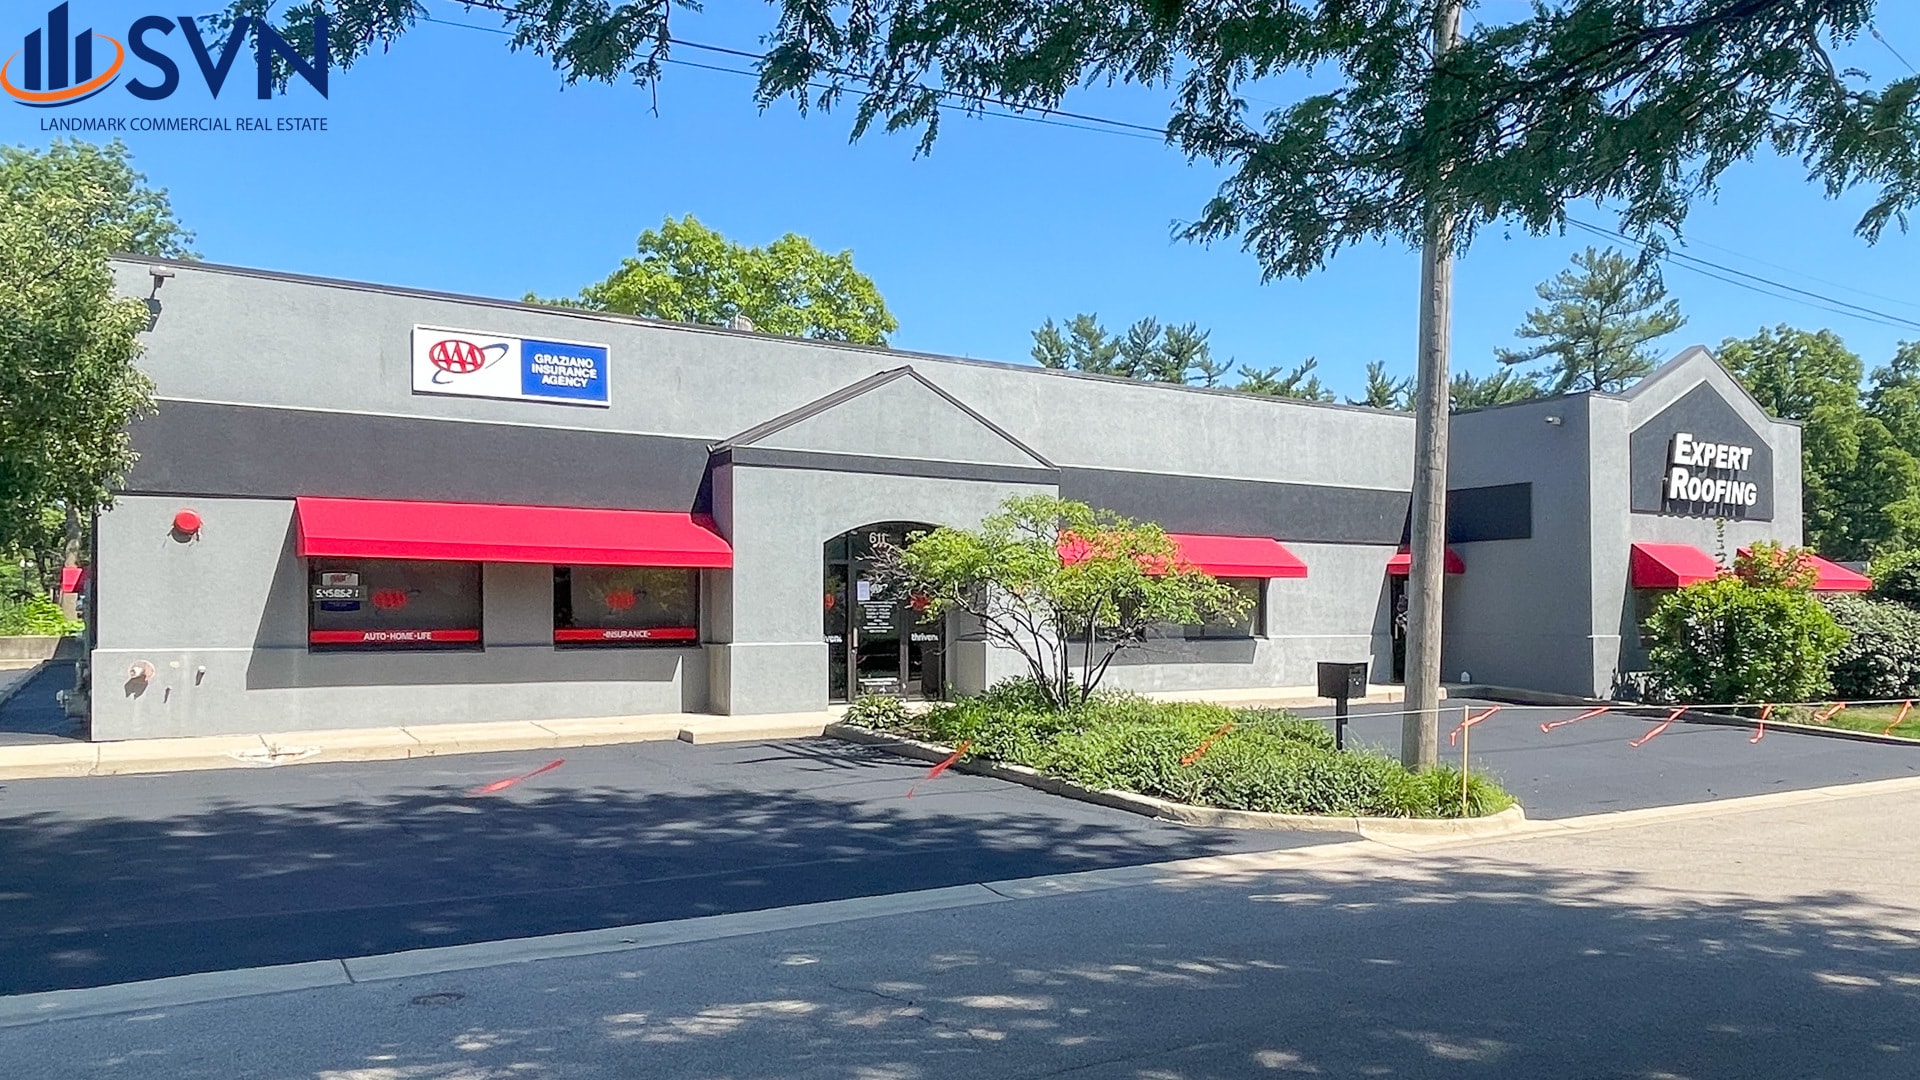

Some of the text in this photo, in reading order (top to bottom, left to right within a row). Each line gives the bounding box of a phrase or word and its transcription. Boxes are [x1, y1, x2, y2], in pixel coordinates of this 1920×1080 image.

[436, 341, 478, 373] AAA
[533, 353, 595, 369] GRAZIANO
[531, 363, 597, 379] INSURANCE
[541, 375, 589, 388] AGENCY
[1672, 432, 1753, 471] EXPERT
[1669, 466, 1758, 506] ROOFING
